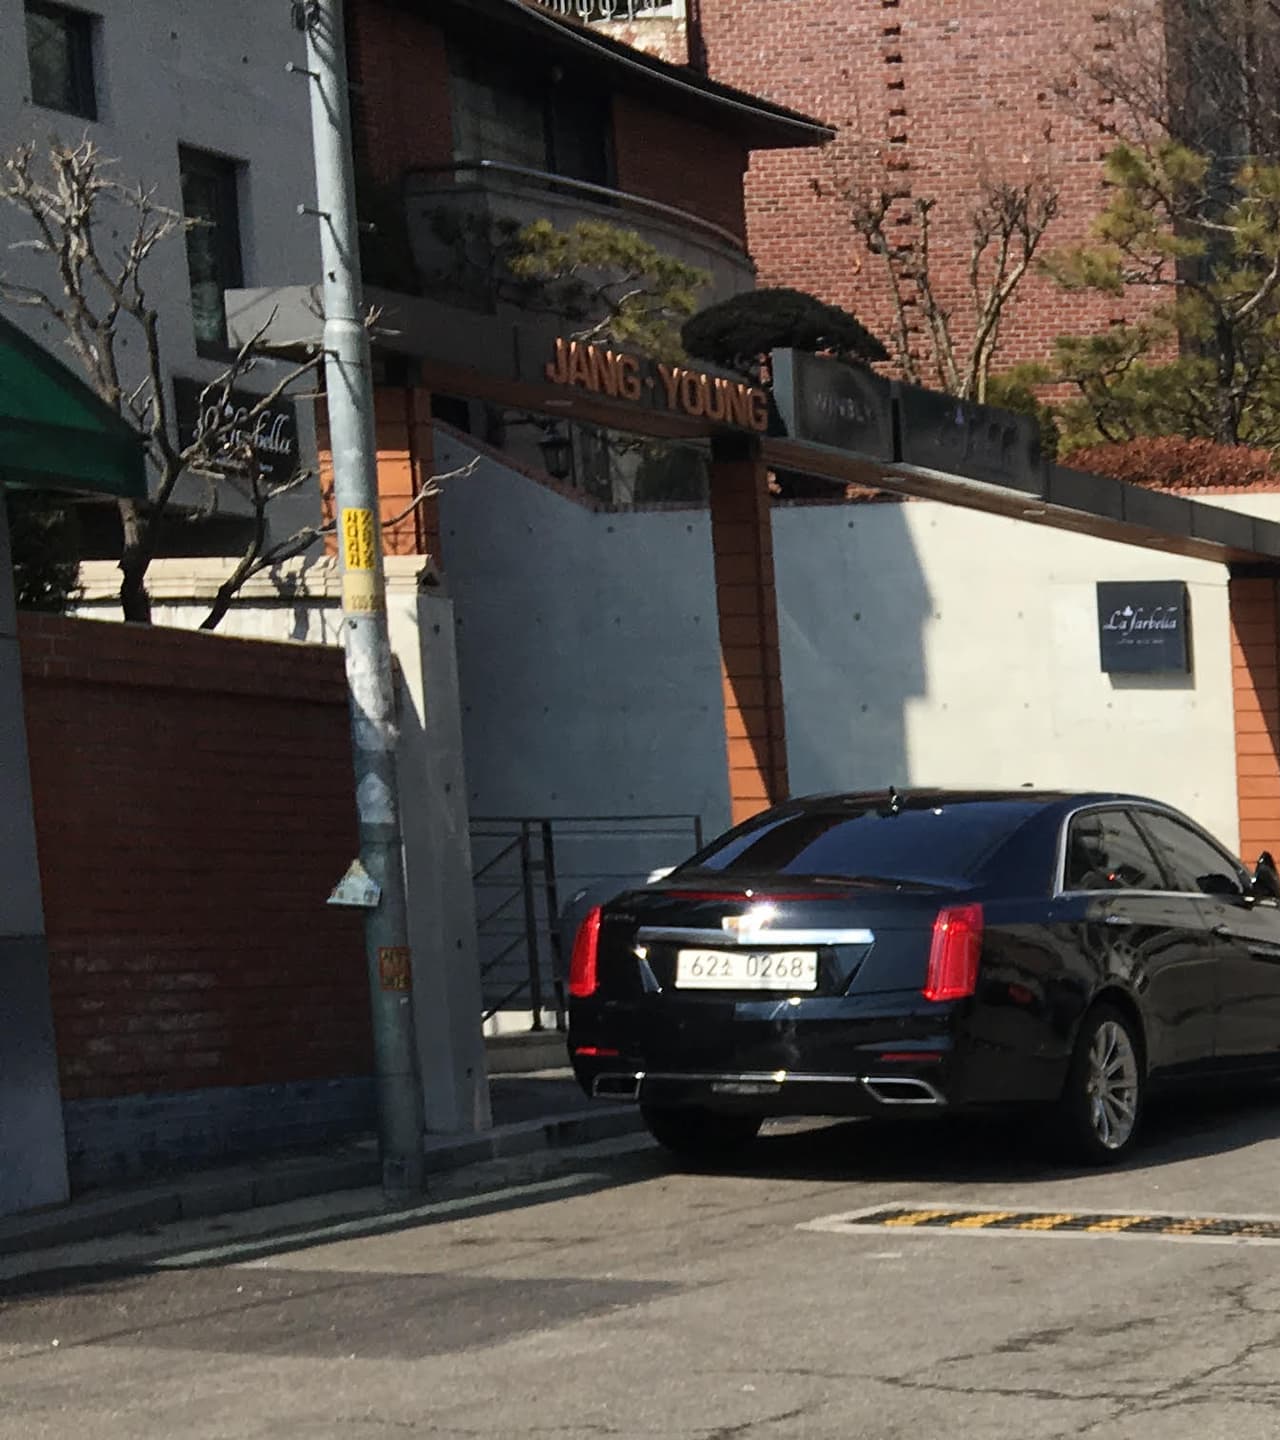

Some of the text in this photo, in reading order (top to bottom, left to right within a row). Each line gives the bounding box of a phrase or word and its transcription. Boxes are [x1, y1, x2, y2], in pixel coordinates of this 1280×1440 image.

[545, 337, 641, 400] JANG
[658, 363, 769, 432] YOUNG
[746, 954, 803, 978] 0268
